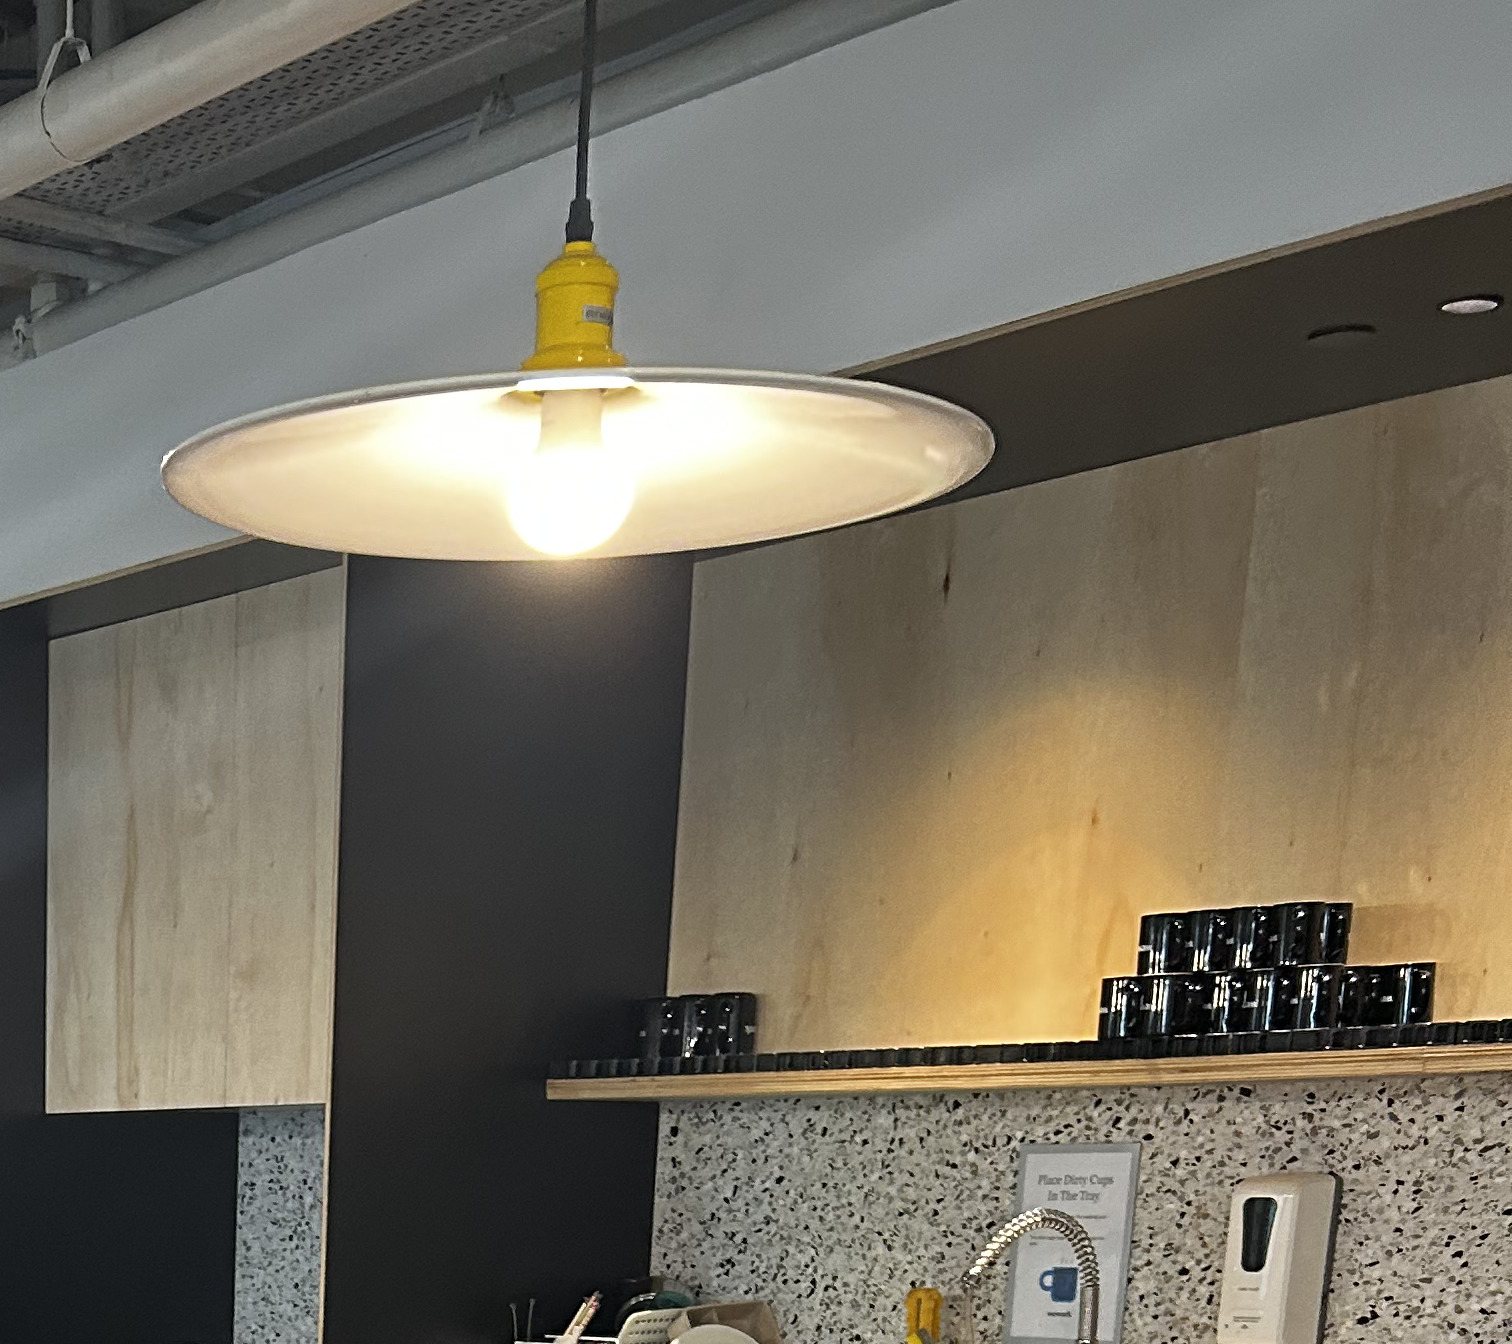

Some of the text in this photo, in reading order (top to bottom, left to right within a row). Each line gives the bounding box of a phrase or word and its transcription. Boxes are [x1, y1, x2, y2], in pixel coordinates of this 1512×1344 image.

[1037, 1174, 1114, 1188] Place Dirty Cups
[1060, 1190, 1078, 1201] The
